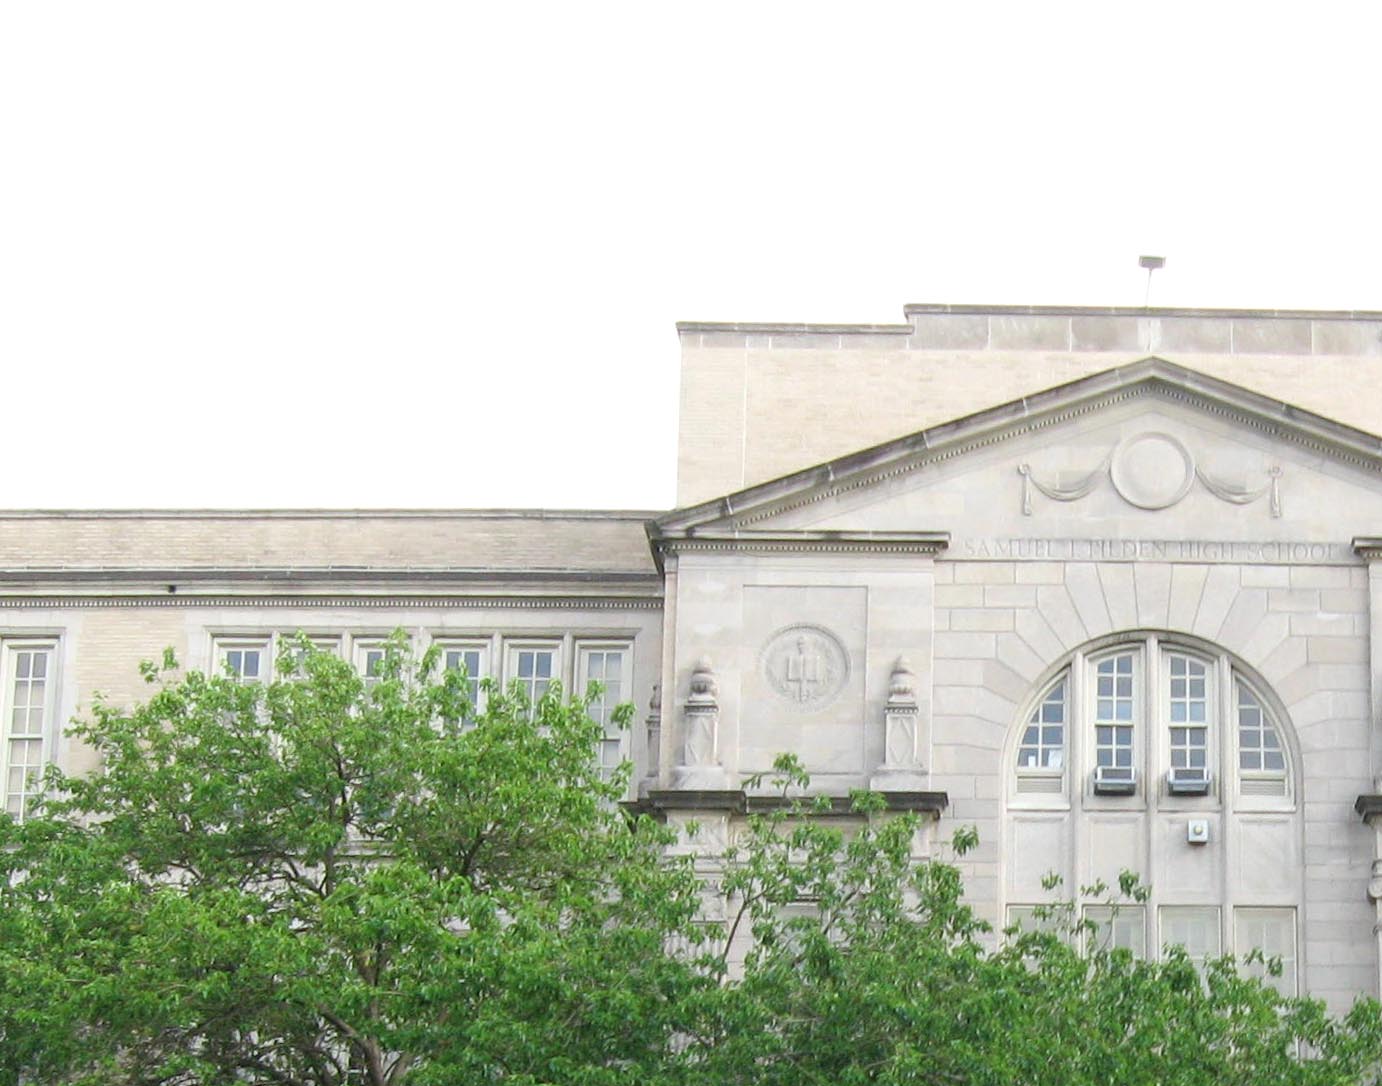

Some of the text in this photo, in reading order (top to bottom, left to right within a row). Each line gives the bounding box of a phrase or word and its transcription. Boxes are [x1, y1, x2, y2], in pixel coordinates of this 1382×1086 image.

[964, 540, 1057, 558] SAMUEL
[1090, 540, 1167, 560] TILDEN
[1180, 541, 1234, 560] HIGH
[1248, 542, 1337, 562] SCHOOL
